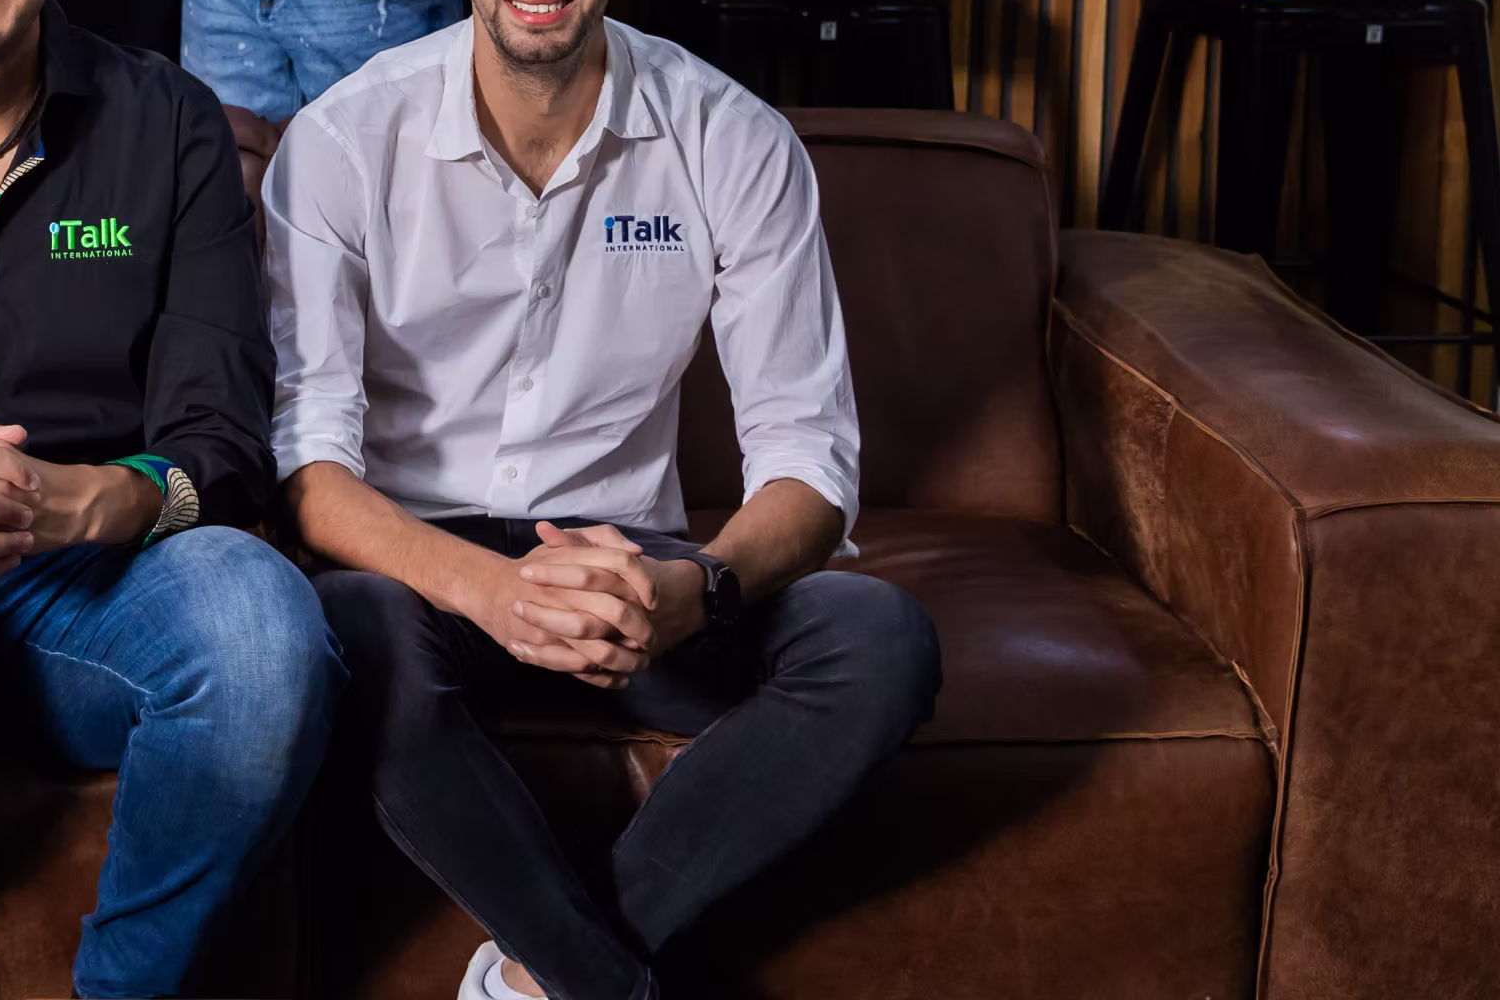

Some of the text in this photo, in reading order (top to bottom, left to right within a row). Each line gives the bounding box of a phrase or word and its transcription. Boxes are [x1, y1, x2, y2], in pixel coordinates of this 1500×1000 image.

[49, 217, 132, 250] iTalk
[604, 215, 683, 243] iTalk
[51, 249, 133, 259] INTERNATIONAL
